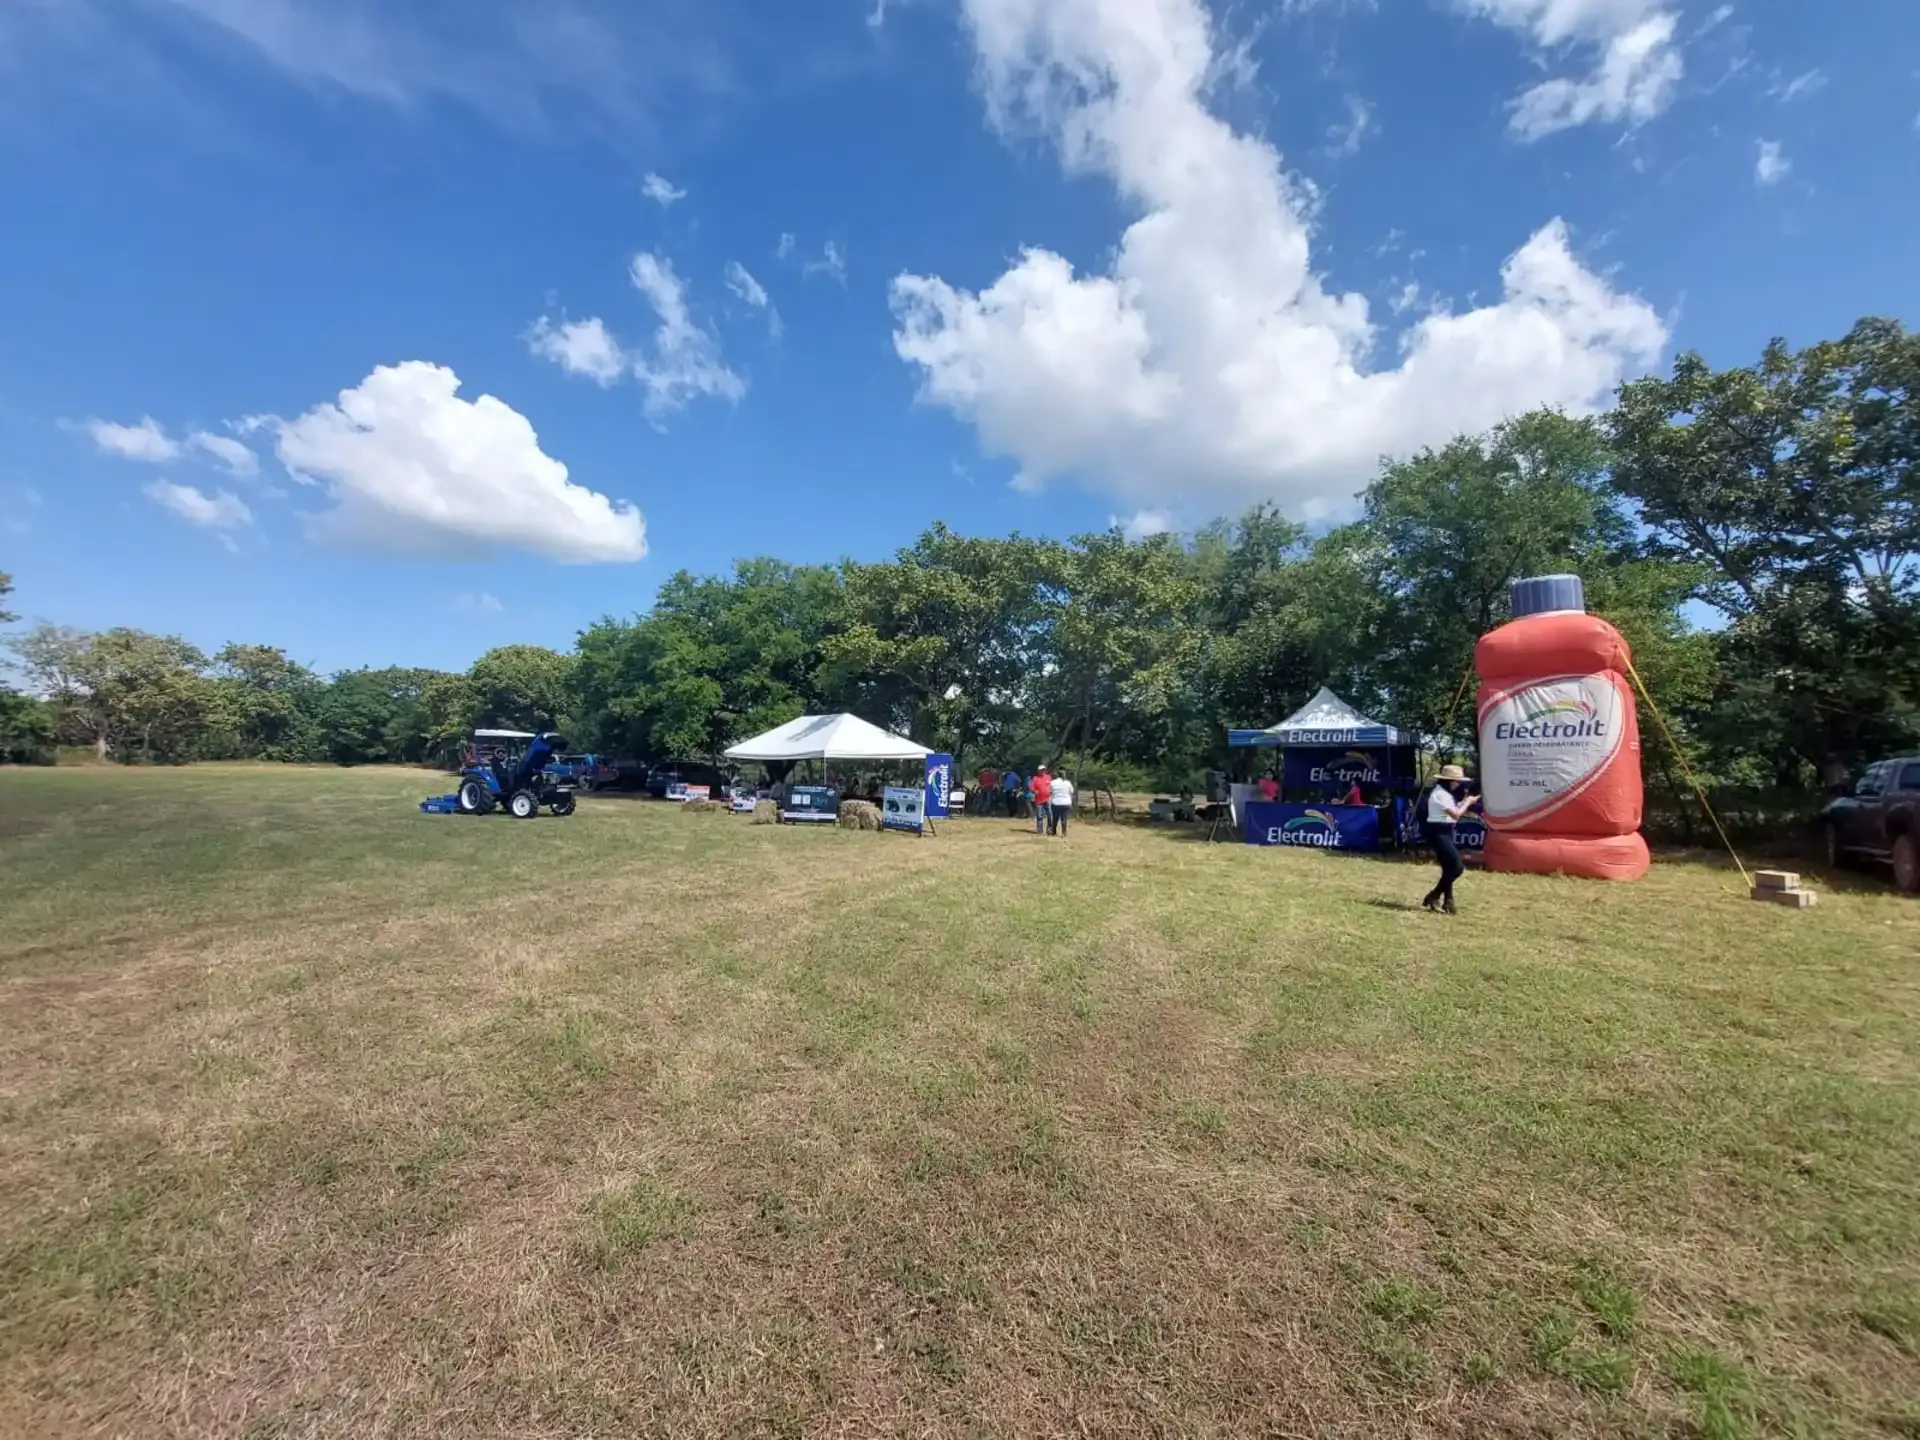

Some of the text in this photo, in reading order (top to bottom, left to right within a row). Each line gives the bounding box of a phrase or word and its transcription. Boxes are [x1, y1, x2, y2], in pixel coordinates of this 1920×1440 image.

[1288, 729, 1359, 743] Electrolit
[1495, 720, 1606, 740] Electrolit
[1266, 827, 1343, 847] Electrolit
